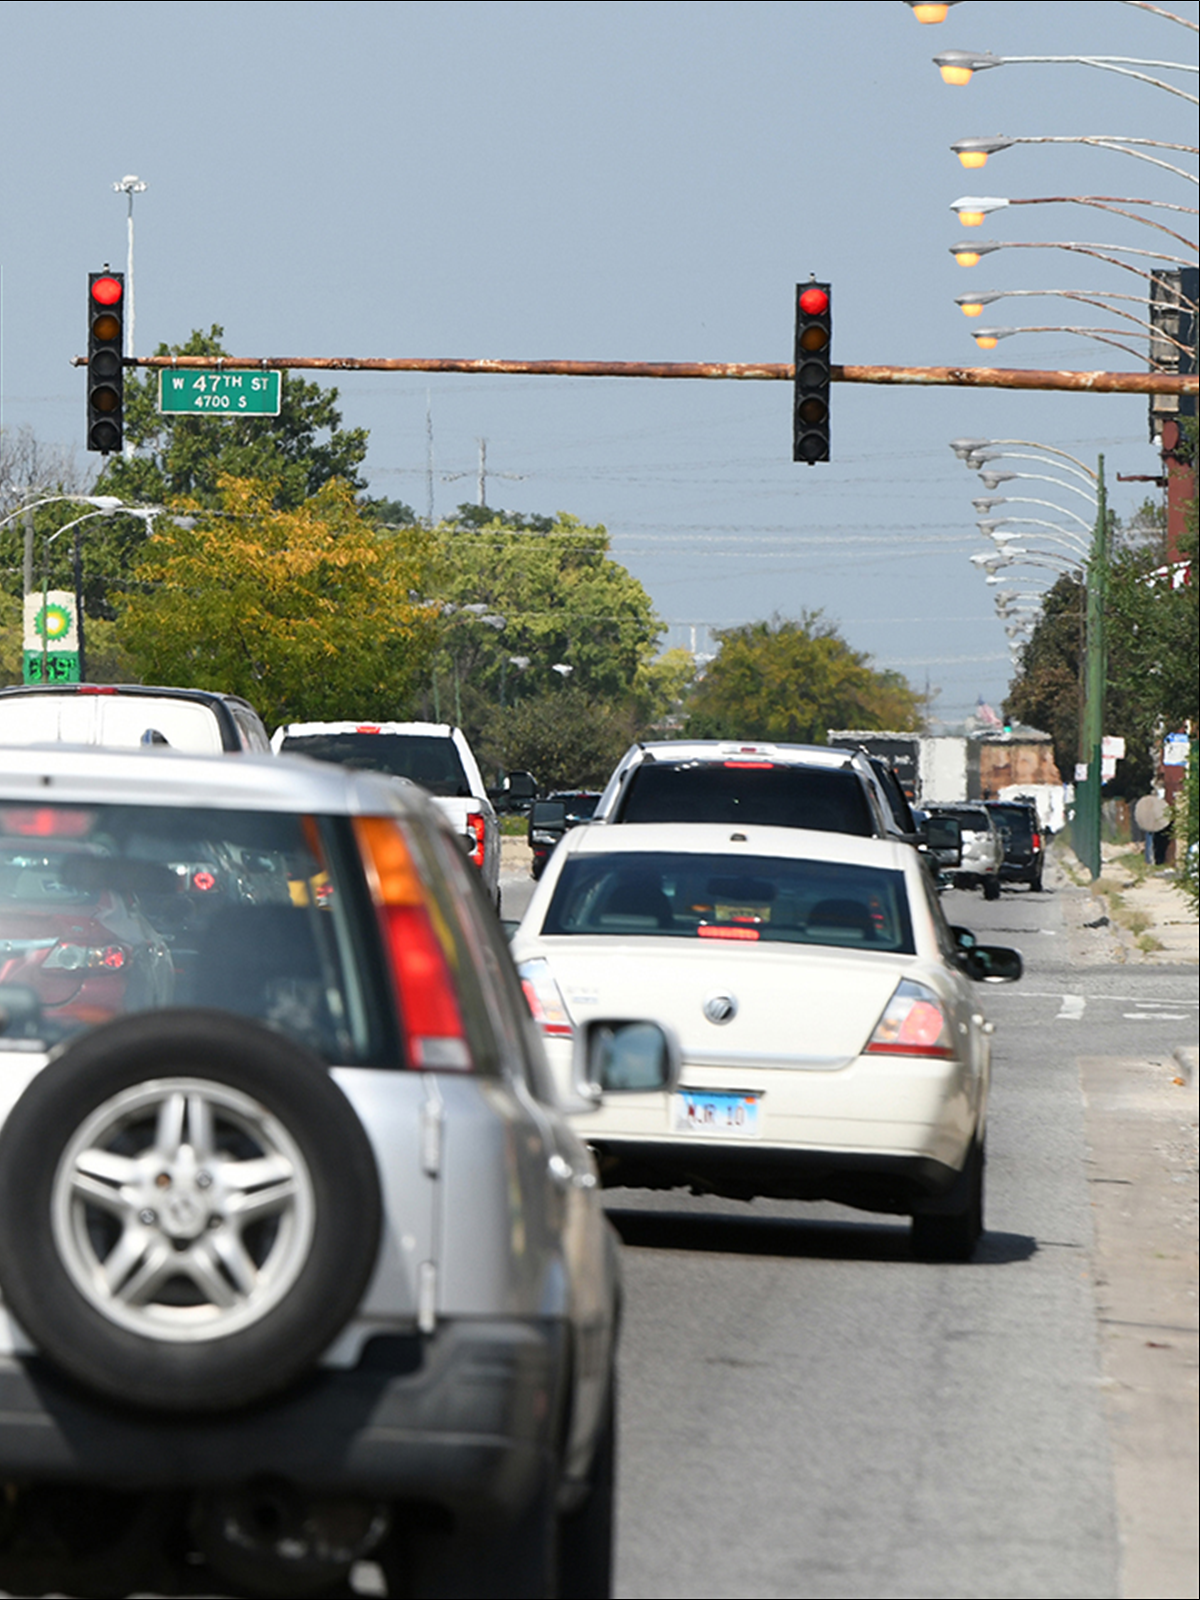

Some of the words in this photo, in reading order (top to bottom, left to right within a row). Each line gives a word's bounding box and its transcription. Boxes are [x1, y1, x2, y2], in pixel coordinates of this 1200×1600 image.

[172, 378, 184, 389] W
[192, 375, 242, 392] 47TH
[251, 377, 269, 391] ST
[194, 395, 230, 408] 4700
[238, 396, 247, 408] S
